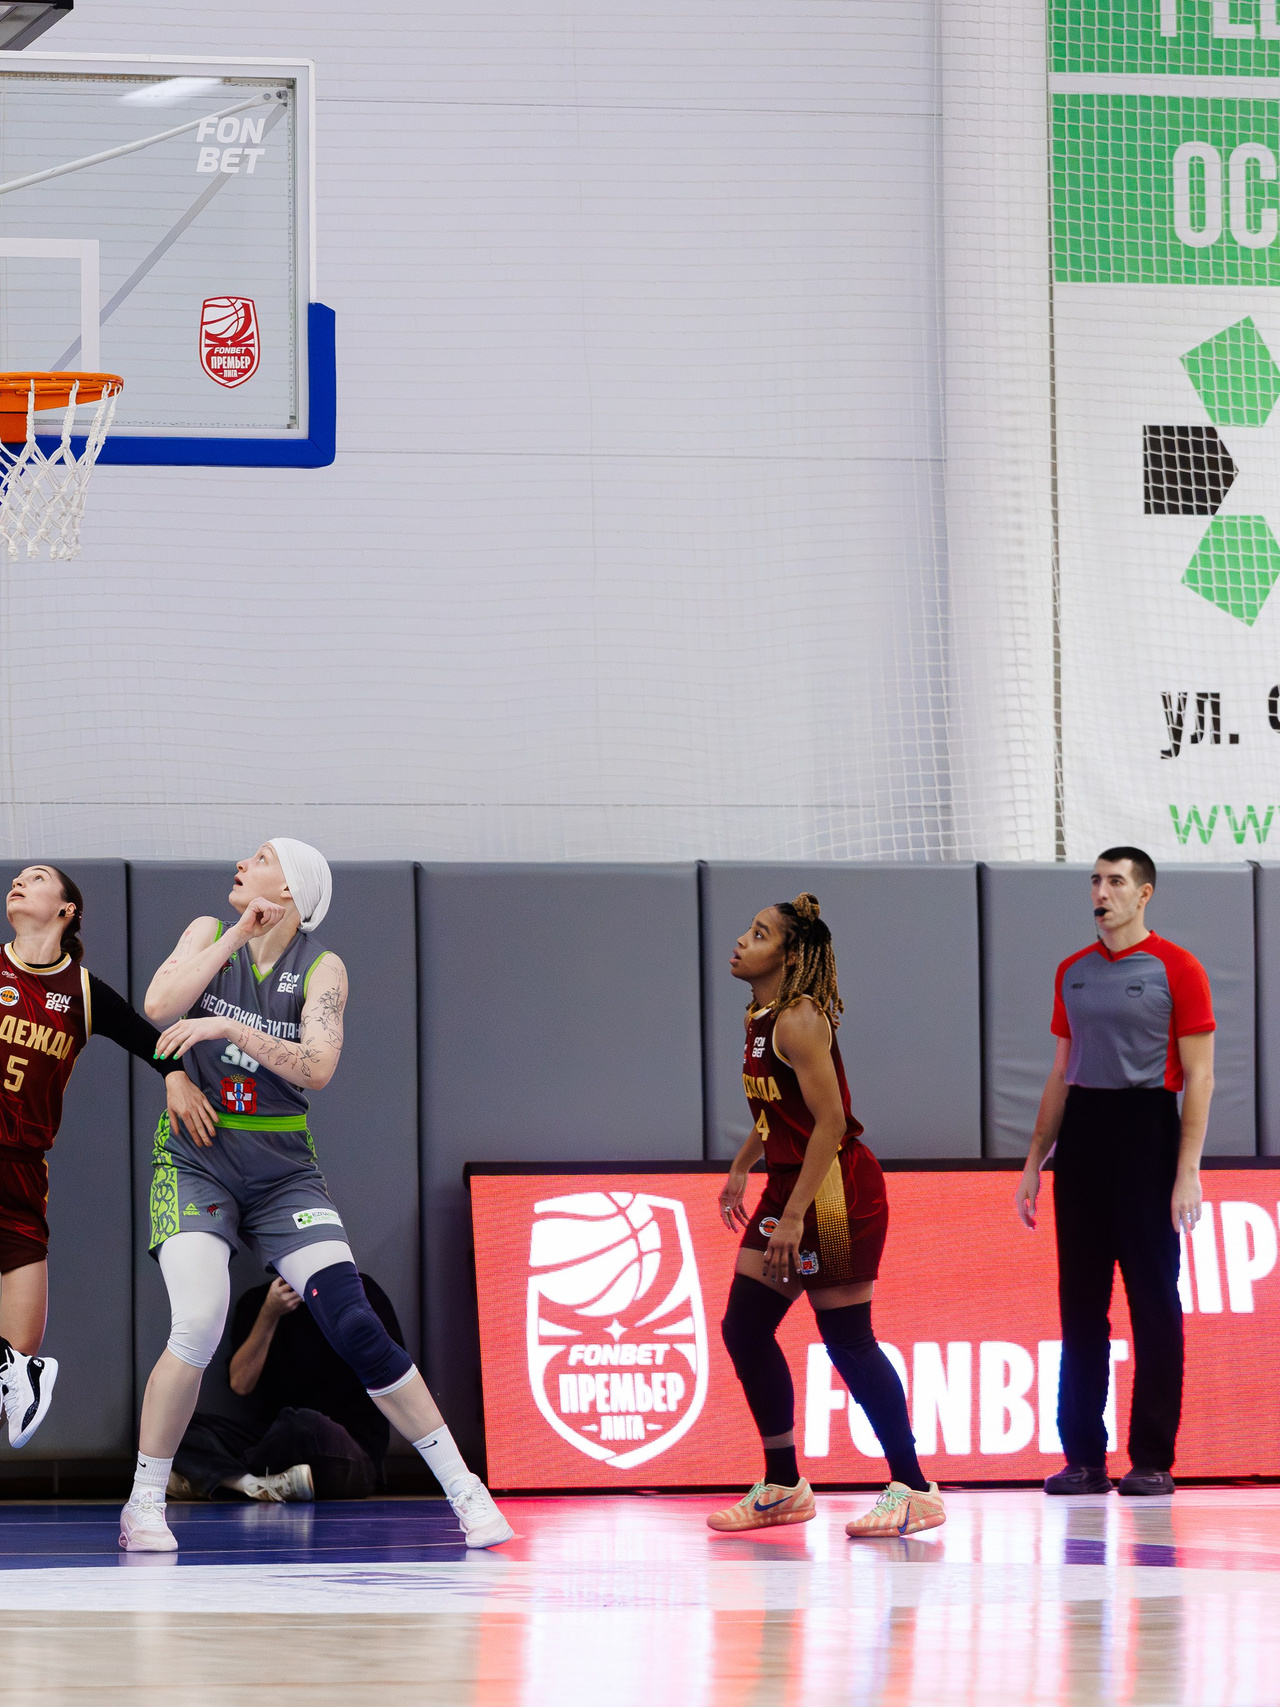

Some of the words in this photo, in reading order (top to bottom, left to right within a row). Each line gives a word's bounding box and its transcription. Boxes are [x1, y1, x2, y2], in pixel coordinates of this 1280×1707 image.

[196, 116, 266, 144] FON
[196, 146, 266, 174] BET
[211, 356, 251, 369] ПРЕМЬЕР
[214, 346, 247, 355] FONBET
[1160, 691, 1239, 760] ул.
[1169, 804, 1280, 845] ww
[45, 992, 72, 1005] FON
[45, 1000, 70, 1013] BET
[3, 1055, 29, 1092] 5
[755, 1109, 770, 1142] 4
[567, 1343, 670, 1366] FONBET
[559, 1372, 686, 1413] ПРЕМЬЕР
[600, 1415, 646, 1440] ЛИГА
